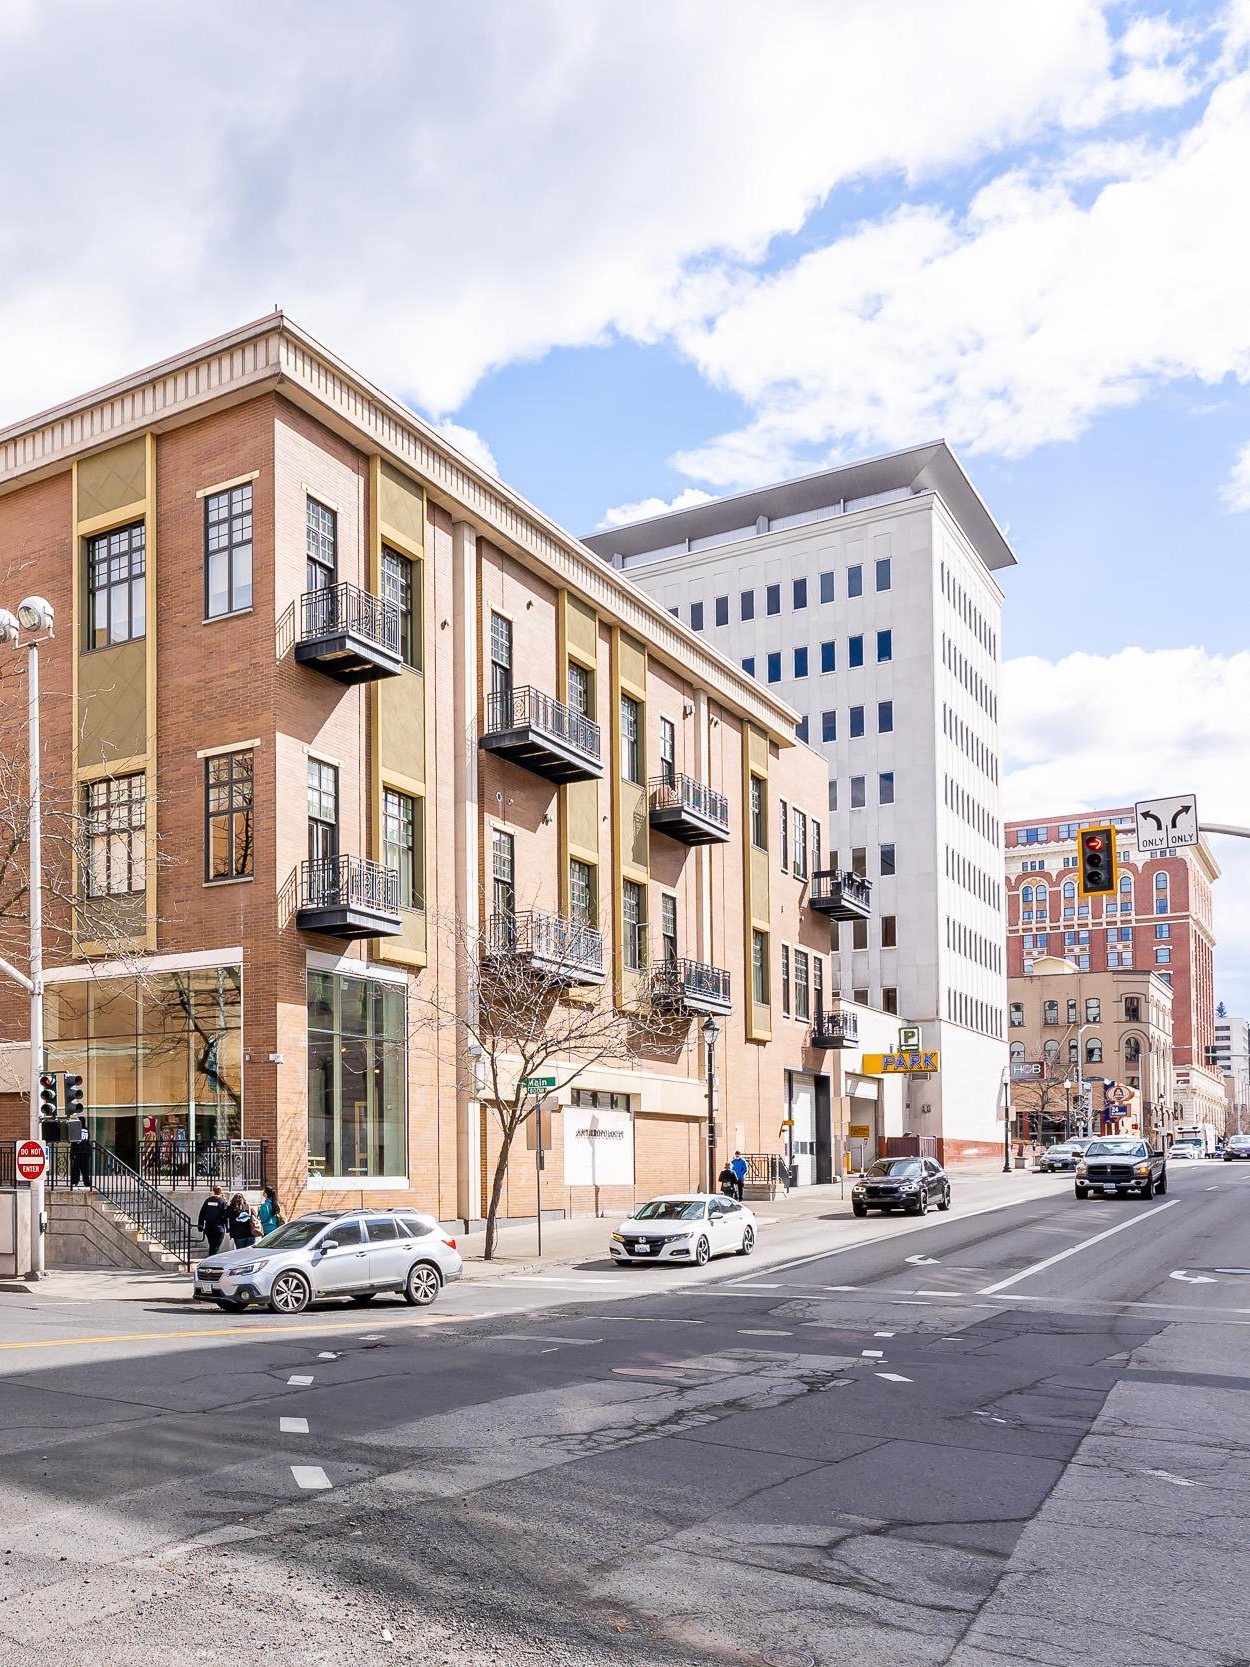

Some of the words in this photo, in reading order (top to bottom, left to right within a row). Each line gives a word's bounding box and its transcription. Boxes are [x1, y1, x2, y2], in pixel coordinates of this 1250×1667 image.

[1142, 837, 1164, 848] ONLY
[1171, 833, 1193, 844] ONLY
[882, 1052, 937, 1071] PARK
[528, 1078, 547, 1087] Main
